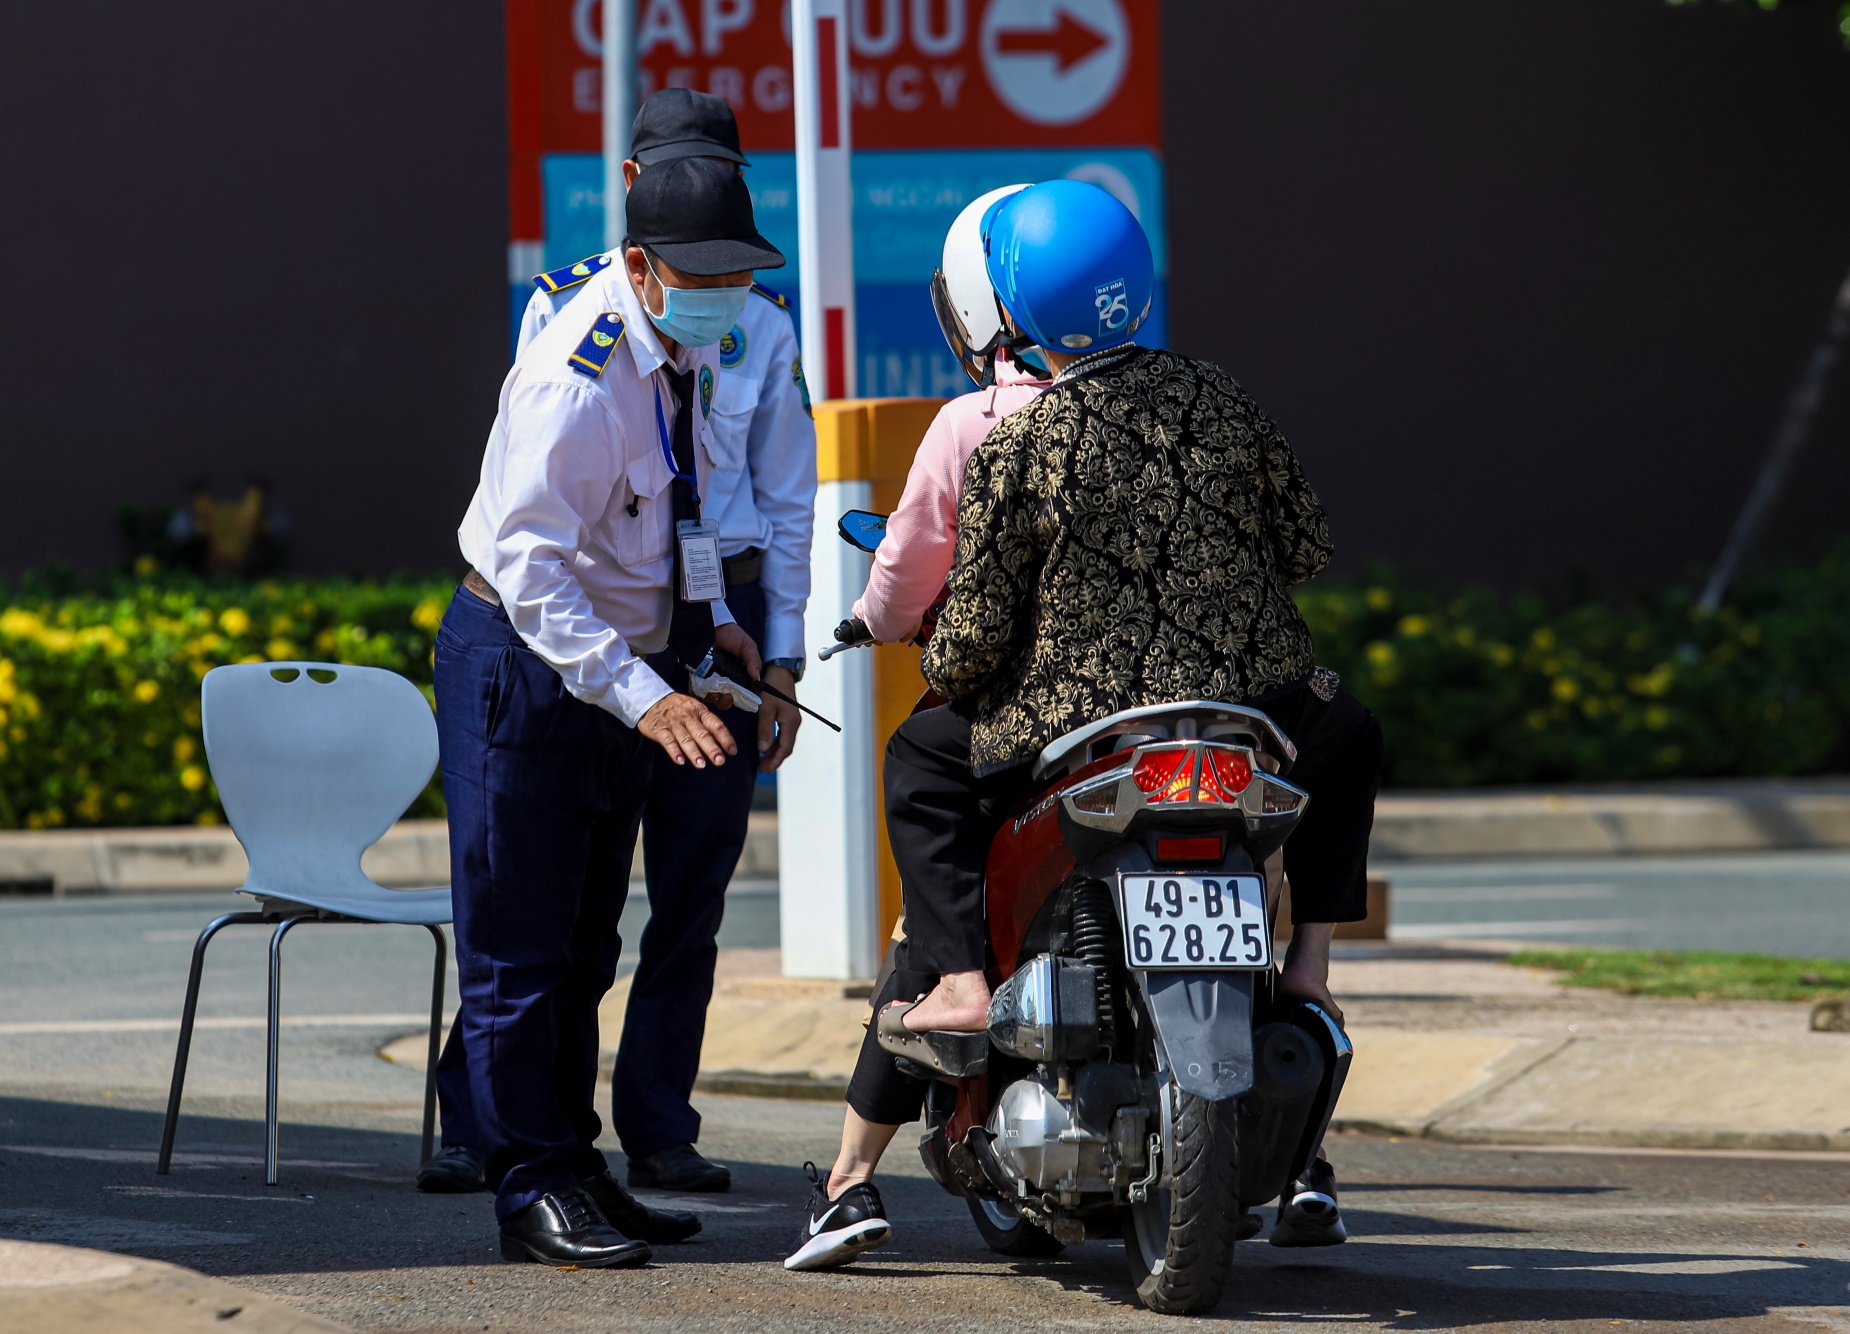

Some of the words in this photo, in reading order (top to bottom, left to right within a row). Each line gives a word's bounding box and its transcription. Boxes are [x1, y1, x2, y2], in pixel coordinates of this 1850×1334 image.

[1095, 294, 1129, 329] 25
[1144, 879, 1242, 918] 49-B1
[1132, 923, 1263, 963] 628.25
